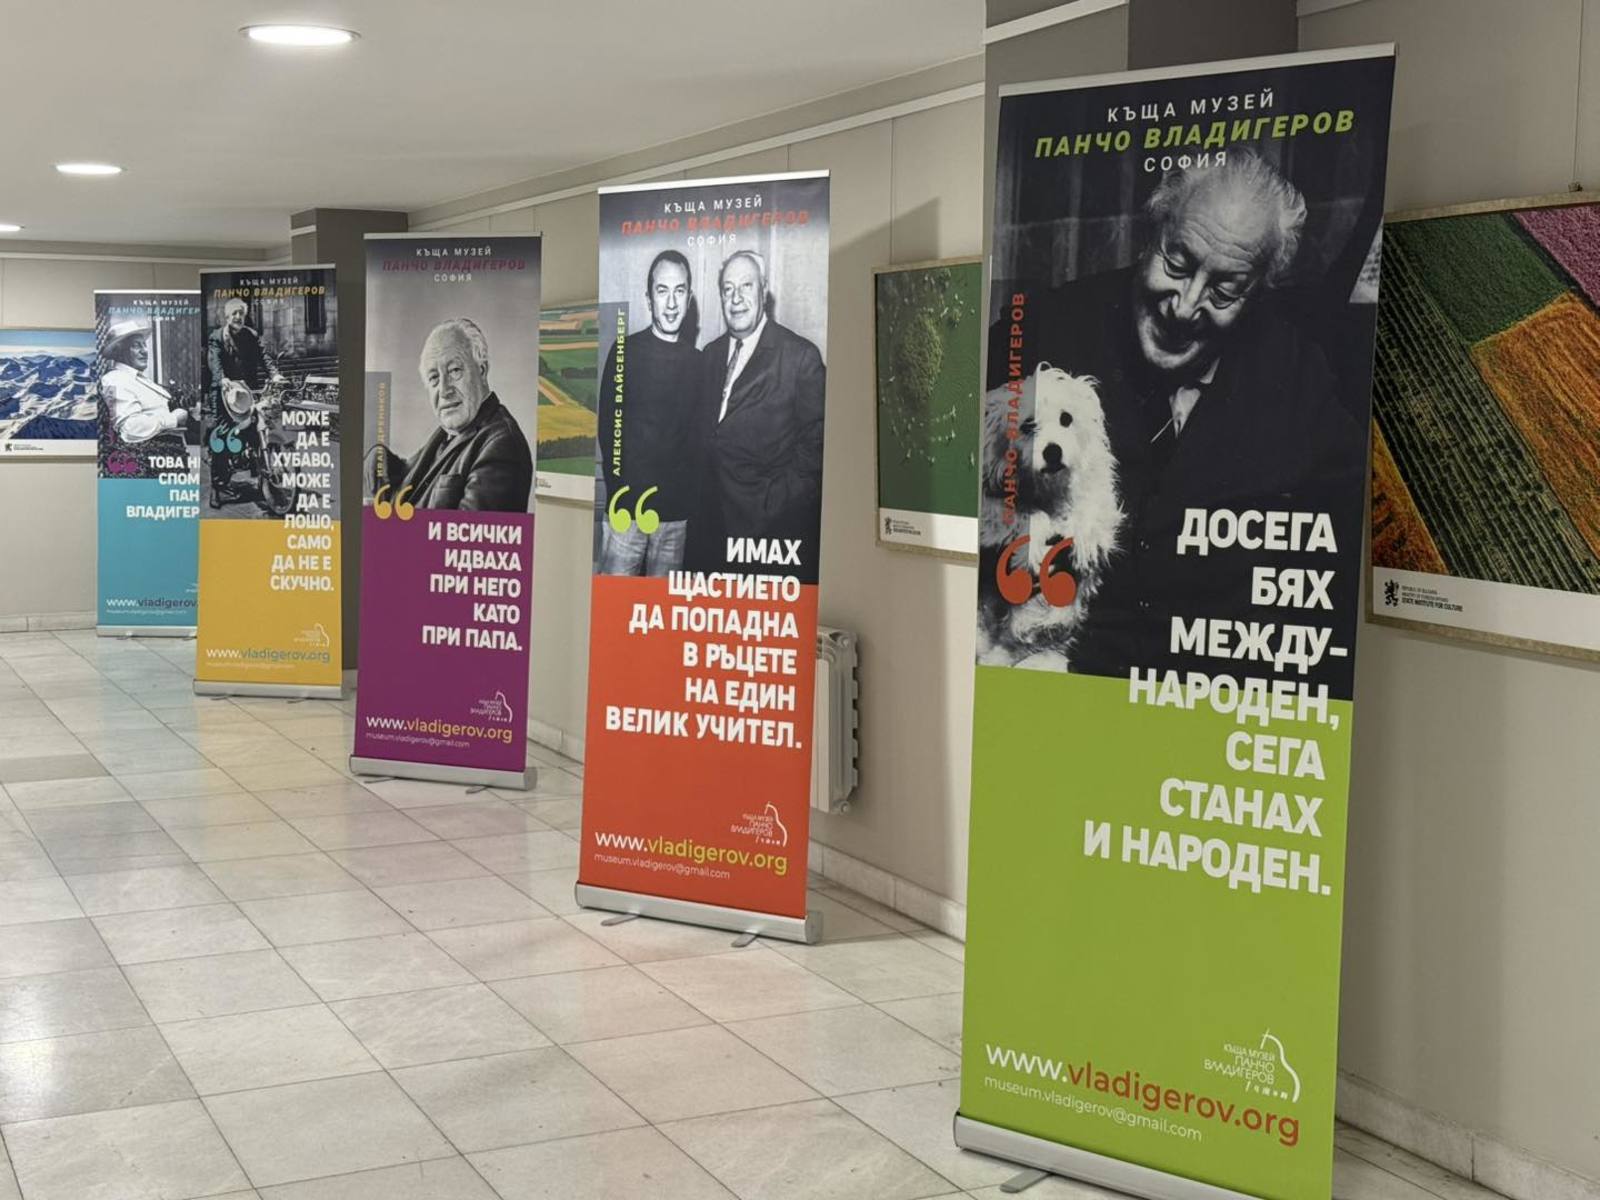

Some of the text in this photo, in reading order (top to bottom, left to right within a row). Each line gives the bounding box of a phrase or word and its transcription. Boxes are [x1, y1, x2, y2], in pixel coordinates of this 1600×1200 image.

[1107, 88, 1274, 123] КЪЩА МУЗЕЙ
[1035, 109, 1354, 158] ПАНЧО ВЛАДИГЕРОВ
[1144, 151, 1227, 173] СОФИЯ
[664, 194, 763, 214] КЪЩА МУЗЕЙ
[621, 210, 811, 235] ПАНЧО ВЛАДИГЕРОВ
[416, 246, 492, 257] КЪЩА МУЗЕЙ
[687, 234, 737, 247] СОФИЯ
[382, 258, 526, 272] ПАНЧО ВЛАДИГЕРОВ
[434, 273, 472, 282] СОФИЯ
[214, 286, 325, 299] ПАНЧО ВЛАДИГЕРОВ
[1007, 293, 1025, 439] ВЛАДИГЕРОВ
[612, 309, 626, 477] АЛЕКСИС ВАЙСЕНБЕРГ
[282, 411, 330, 426] МОЖЕ
[296, 432, 330, 449] ДА Е
[148, 456, 184, 469] ТОВА
[272, 452, 334, 469] ХУБАВО,
[282, 473, 331, 488] МОЖЕ
[169, 489, 199, 501] ПАН
[296, 493, 331, 511] ДА Е
[284, 514, 334, 531] ЛОШО,
[428, 521, 522, 544] И ВСИЧКИ
[1176, 507, 1338, 556] ДОСЕГА
[287, 535, 332, 550] САМО
[726, 537, 802, 566] ИМАХ
[271, 555, 332, 573] ДА НЕ Е
[444, 548, 522, 572] ИДВАХА
[270, 575, 334, 591] СКУЧНО.
[430, 573, 521, 598] ПРИ НЕГО
[668, 570, 800, 602] ЩАСТИЕТО
[1251, 566, 1336, 610] БЯХ
[473, 602, 521, 624] КАТО
[628, 603, 799, 642] ДА ПОПАДНА
[422, 625, 523, 651] ПРИ ПАПА.
[1170, 616, 1348, 674] МЕЖДУ-
[683, 641, 797, 678] В РЪЦЕТЕ
[685, 677, 796, 714] НА ЕДИН
[1129, 666, 1340, 730] НАРОДЕН,
[366, 716, 513, 744] www.vladigerov.org
[605, 705, 802, 749] ВЕЛИК УЧИТЕЛ.
[1225, 730, 1326, 780] СЕГА
[1160, 777, 1323, 837] СТАНАХ
[595, 831, 788, 875] www.vladigerov.org
[1083, 819, 1331, 896] И НАРОДЕН.
[594, 853, 730, 880] museum.vladigerov@gmail.com
[1235, 1055, 1275, 1073] ПАНЧО
[985, 1043, 1300, 1147] www.vladigerov.org
[984, 1075, 1202, 1142] museum.vladigerov@gmail.com
